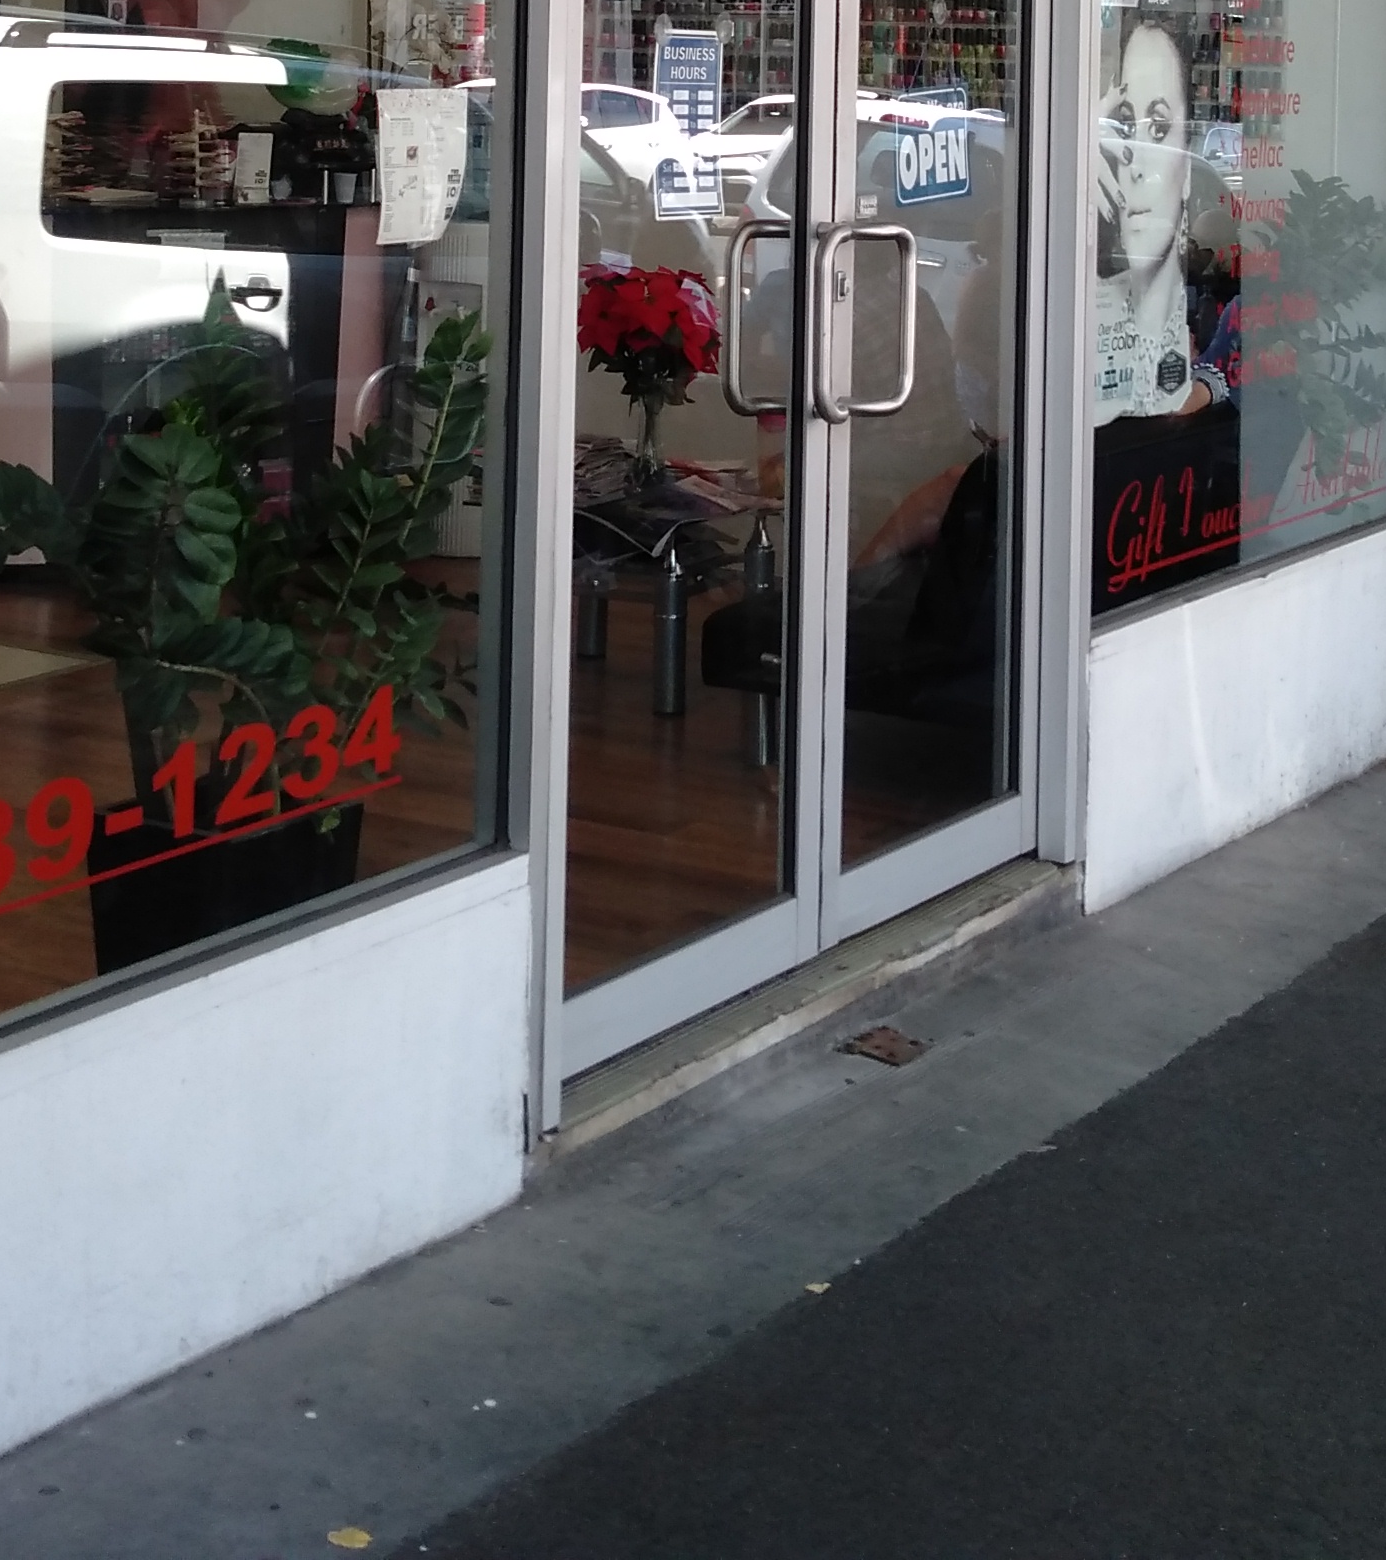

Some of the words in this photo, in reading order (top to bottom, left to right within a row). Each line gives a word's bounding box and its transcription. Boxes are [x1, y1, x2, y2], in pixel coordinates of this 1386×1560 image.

[664, 46, 715, 61] BUSINESS
[670, 66, 707, 80] HOURS
[900, 128, 966, 190] OPEN
[1231, 133, 1284, 171] Shellac
[1230, 190, 1285, 230] Waxing
